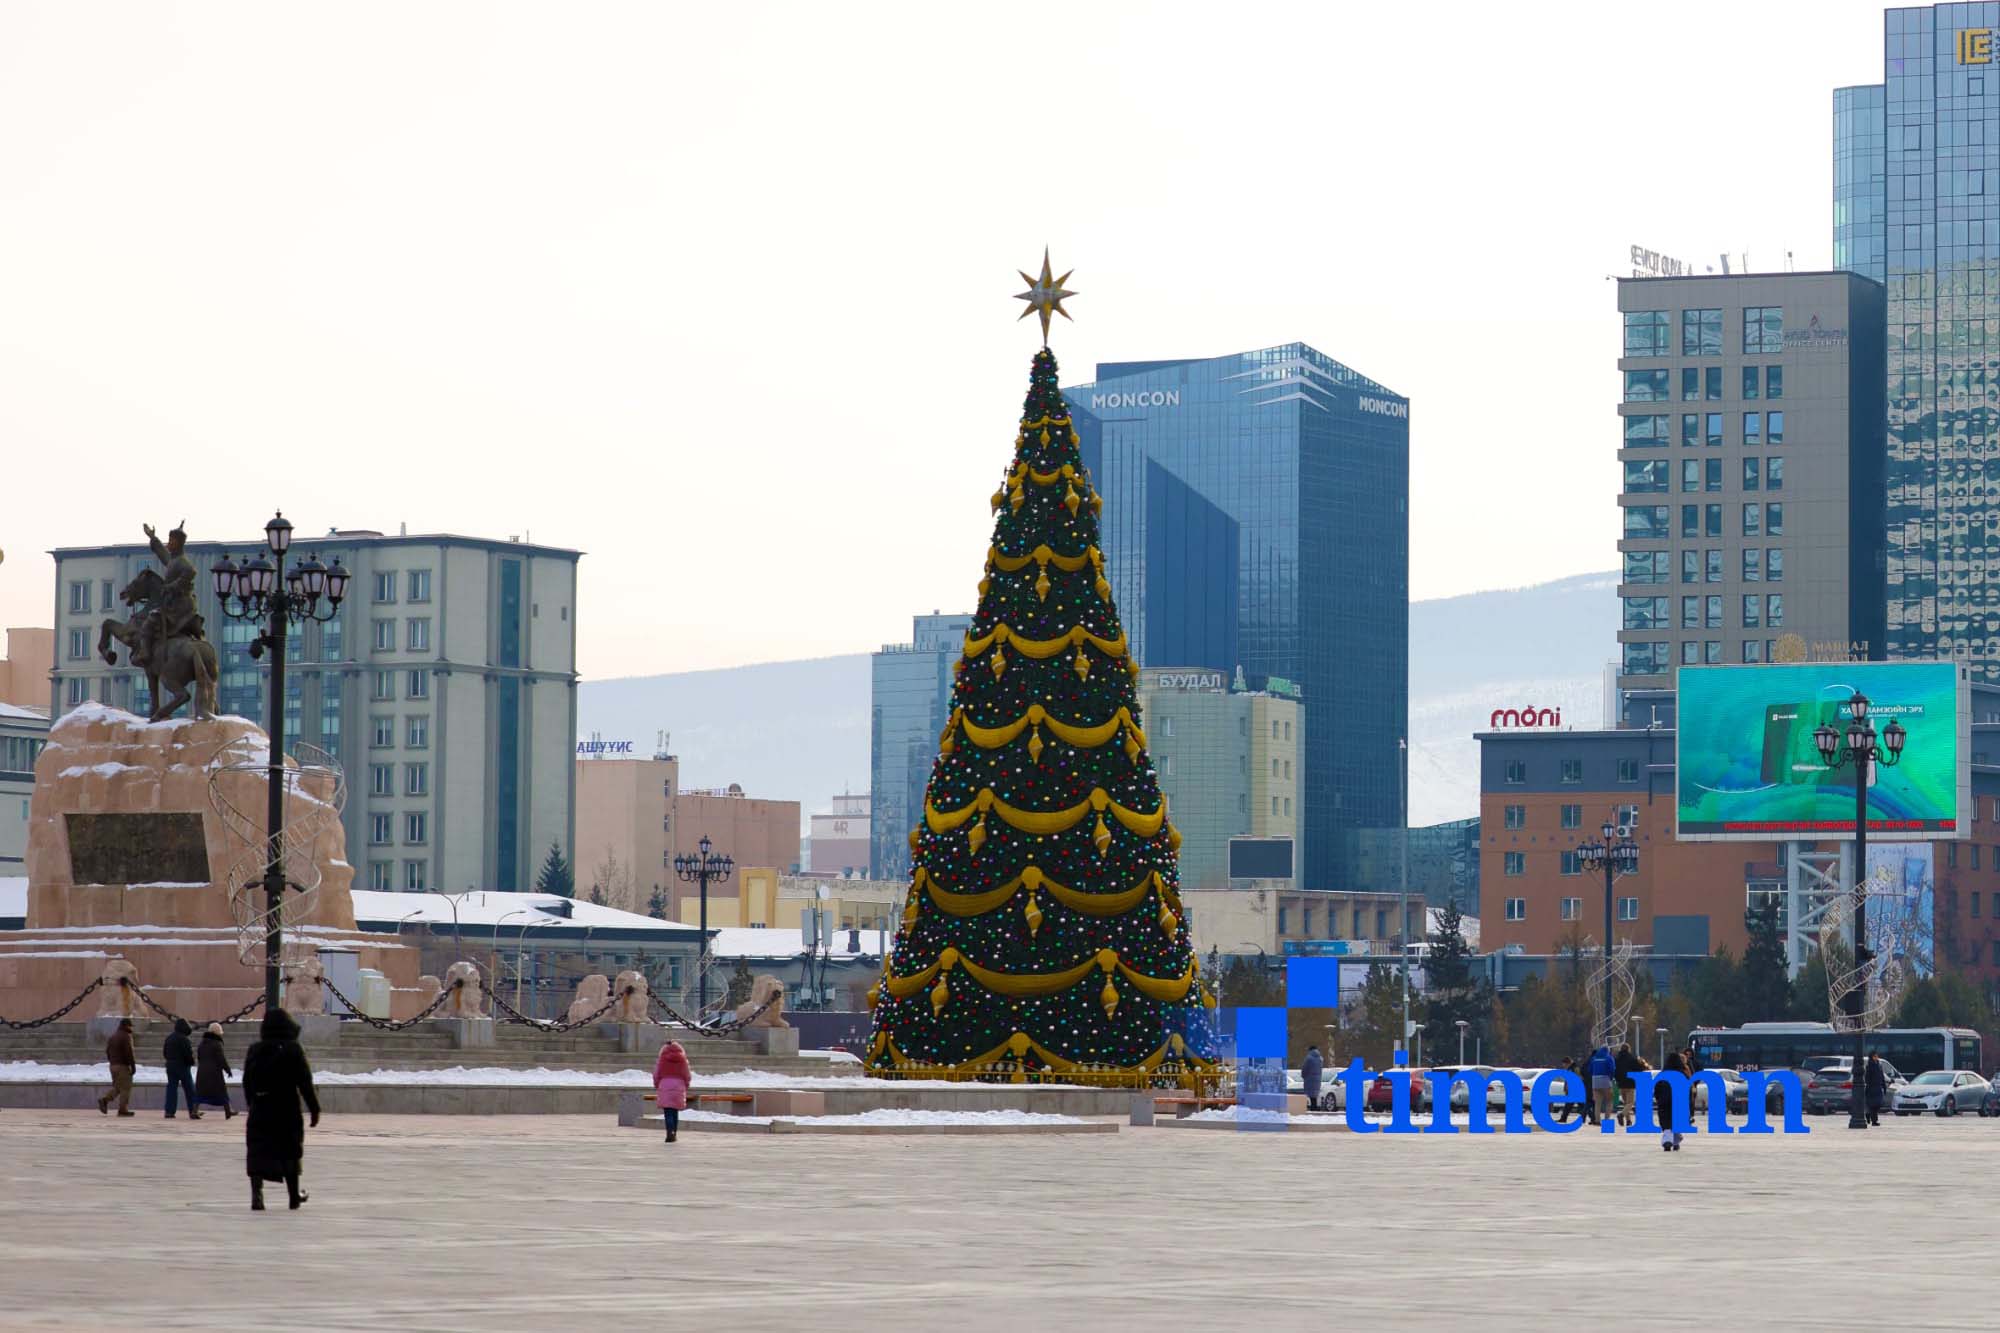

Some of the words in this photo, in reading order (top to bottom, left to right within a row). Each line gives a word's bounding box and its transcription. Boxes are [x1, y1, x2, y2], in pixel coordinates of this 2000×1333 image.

[1091, 390, 1180, 409] MONCON
[1359, 396, 1407, 419] MONCON
[1159, 674, 1222, 690] БУУДАЛ
